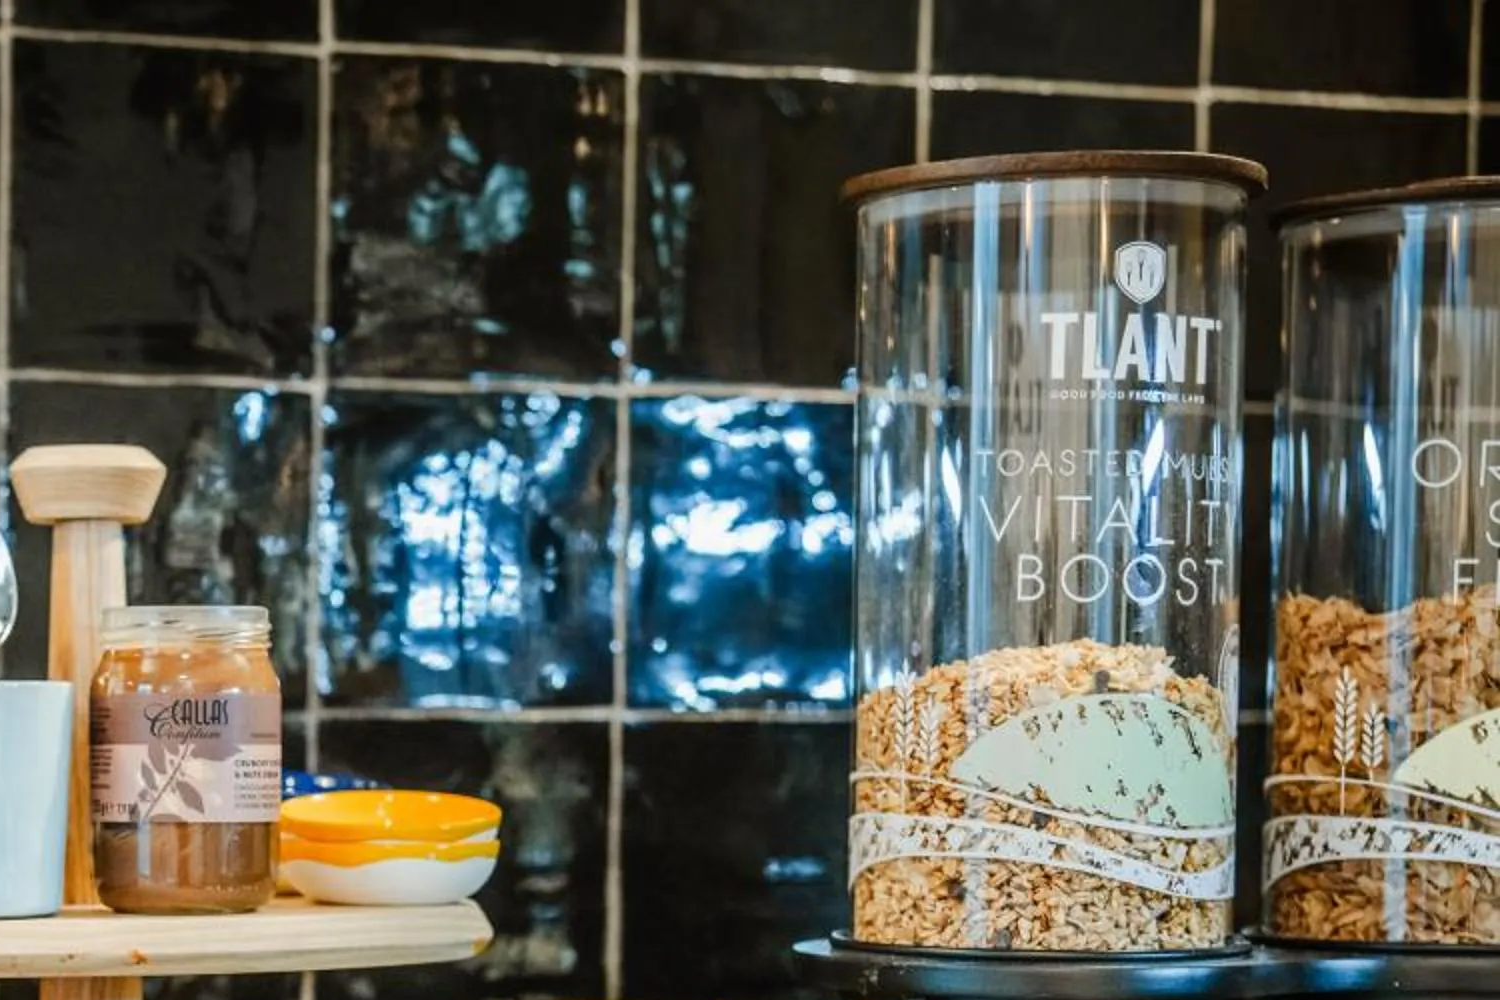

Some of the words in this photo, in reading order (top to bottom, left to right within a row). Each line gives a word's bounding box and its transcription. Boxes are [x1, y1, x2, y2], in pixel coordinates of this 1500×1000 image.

[1041, 312, 1216, 385] TLANT
[975, 450, 1143, 477] TOASTED
[1162, 451, 1229, 483] MUES
[1017, 554, 1223, 607] BOOST
[171, 699, 229, 726] CALLAS
